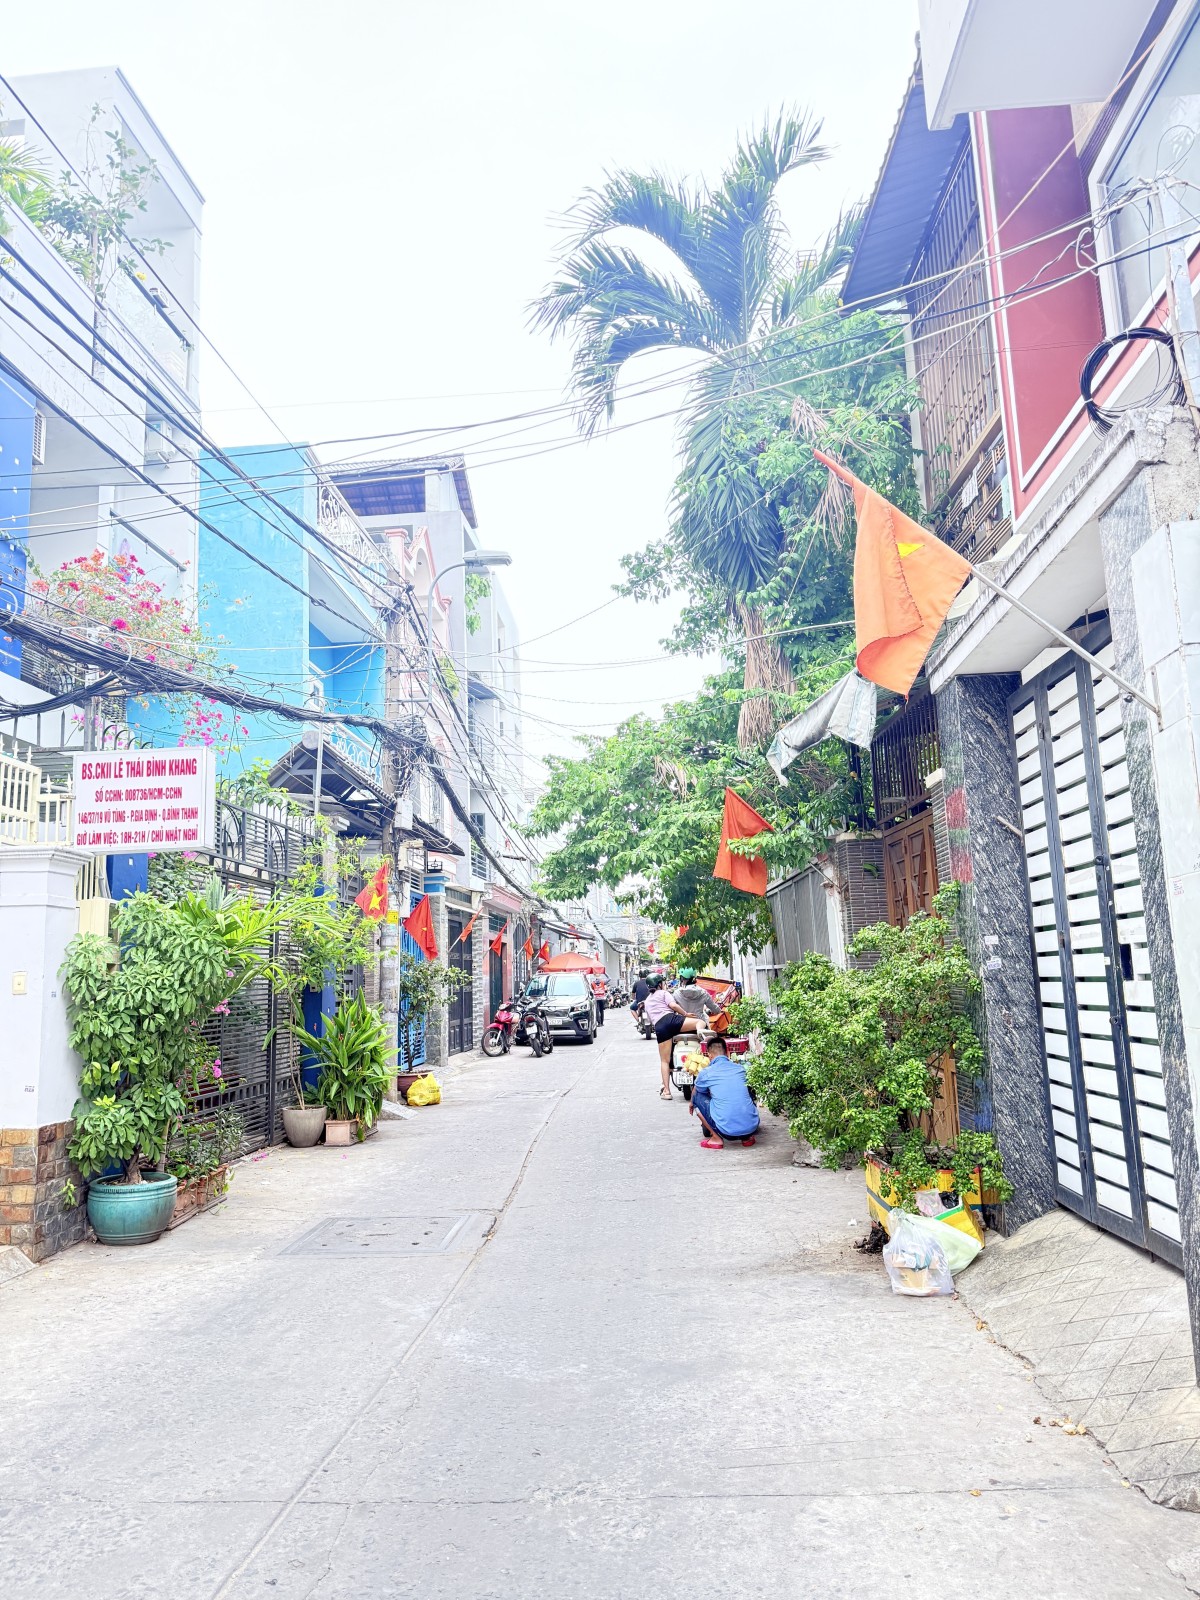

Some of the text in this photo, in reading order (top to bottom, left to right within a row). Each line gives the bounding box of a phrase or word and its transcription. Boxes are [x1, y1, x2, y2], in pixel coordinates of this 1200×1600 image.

[82, 756, 197, 780] BS.CKII LÊ THÁI BÌNH KHANG
[95, 786, 103, 802] SỐ
[105, 789, 123, 801] CCHN:
[130, 810, 143, 822] P.GIA
[144, 809, 157, 824] ĐỊNH
[181, 807, 198, 823] THẠNH
[77, 830, 88, 845] GIỜ
[89, 831, 101, 845] LÀM
[103, 830, 118, 847] VIỆC:
[120, 830, 146, 844] 18H-21H
[151, 826, 164, 842] CHỦ
[165, 828, 181, 844] NHẬT
[183, 824, 198, 841] NGHỈ
